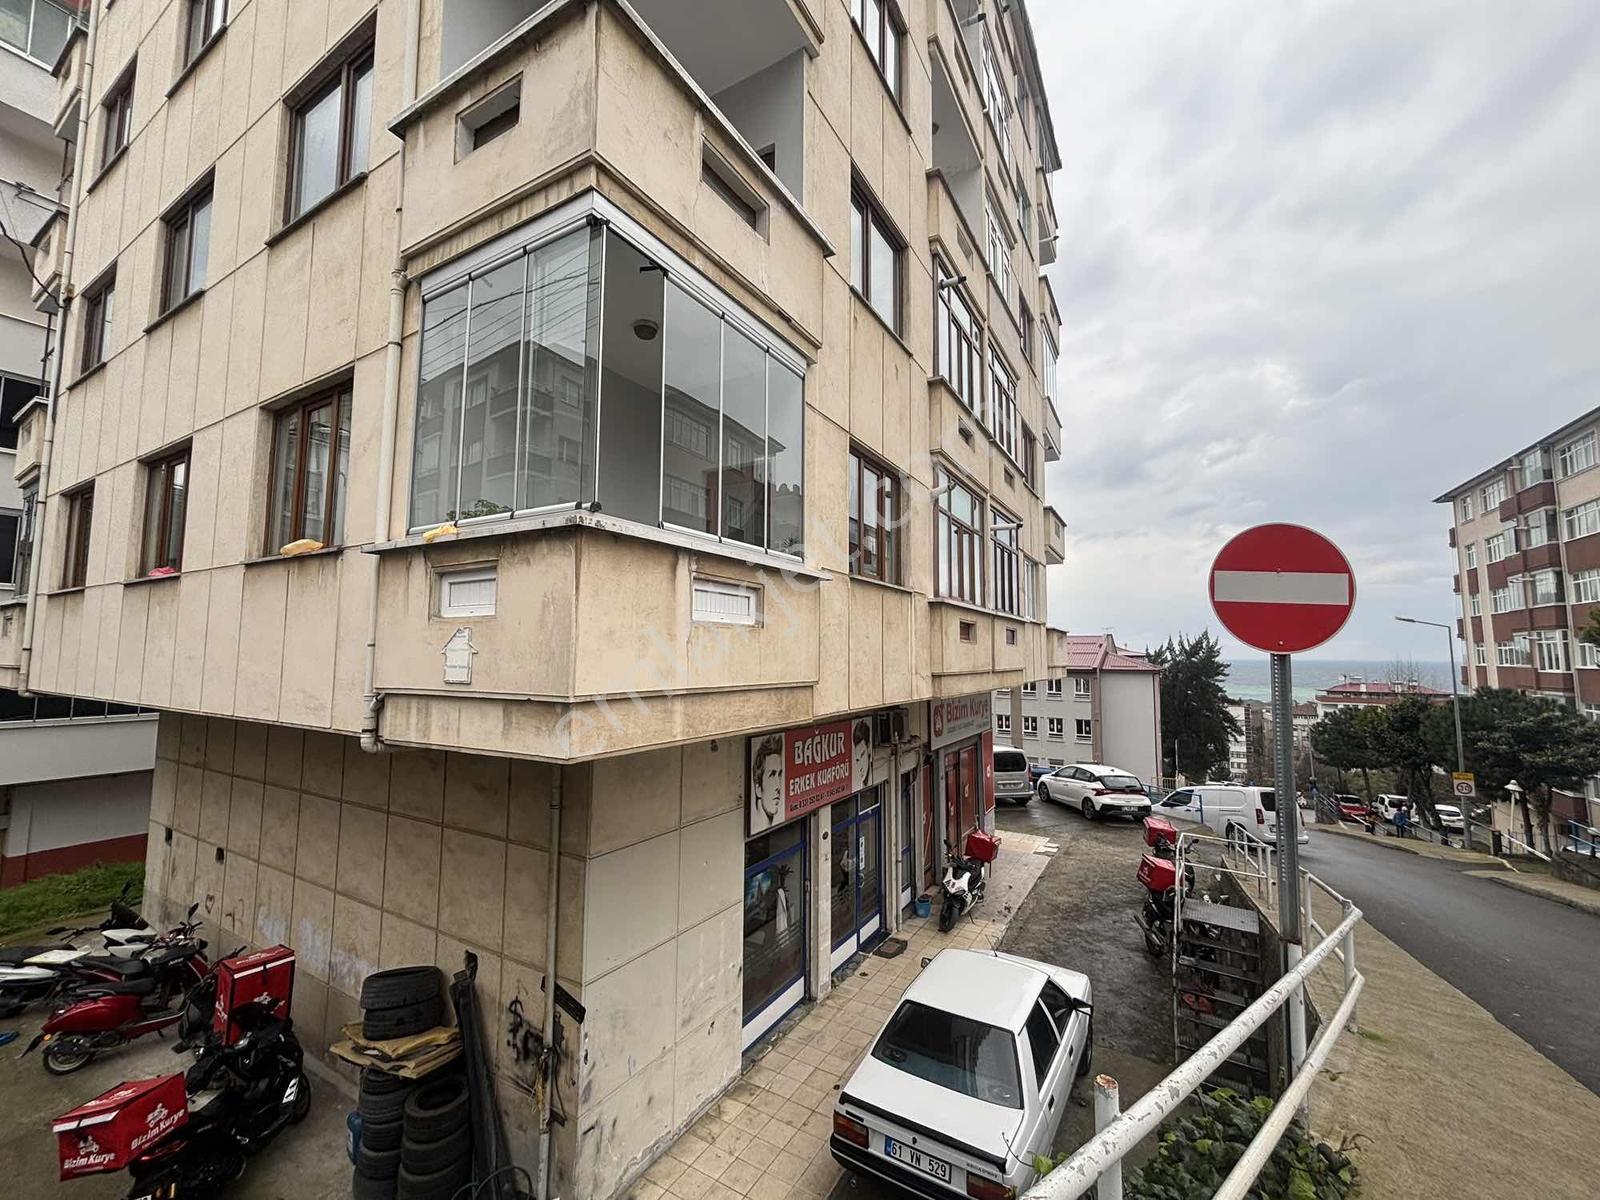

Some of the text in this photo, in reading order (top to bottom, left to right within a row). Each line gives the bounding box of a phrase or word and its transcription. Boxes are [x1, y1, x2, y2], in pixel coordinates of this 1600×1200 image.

[946, 695, 989, 721] Bizim Kurye
[794, 729, 846, 767] BAĞKUR
[789, 772, 816, 797] ERKEK
[817, 758, 850, 787] KUAFÖRÜ
[131, 1126, 160, 1151] Bizim
[159, 1108, 186, 1134] Kurye
[63, 1152, 116, 1169] Bizim Kurye
[891, 1142, 902, 1158] 61
[928, 1158, 947, 1178] 529
